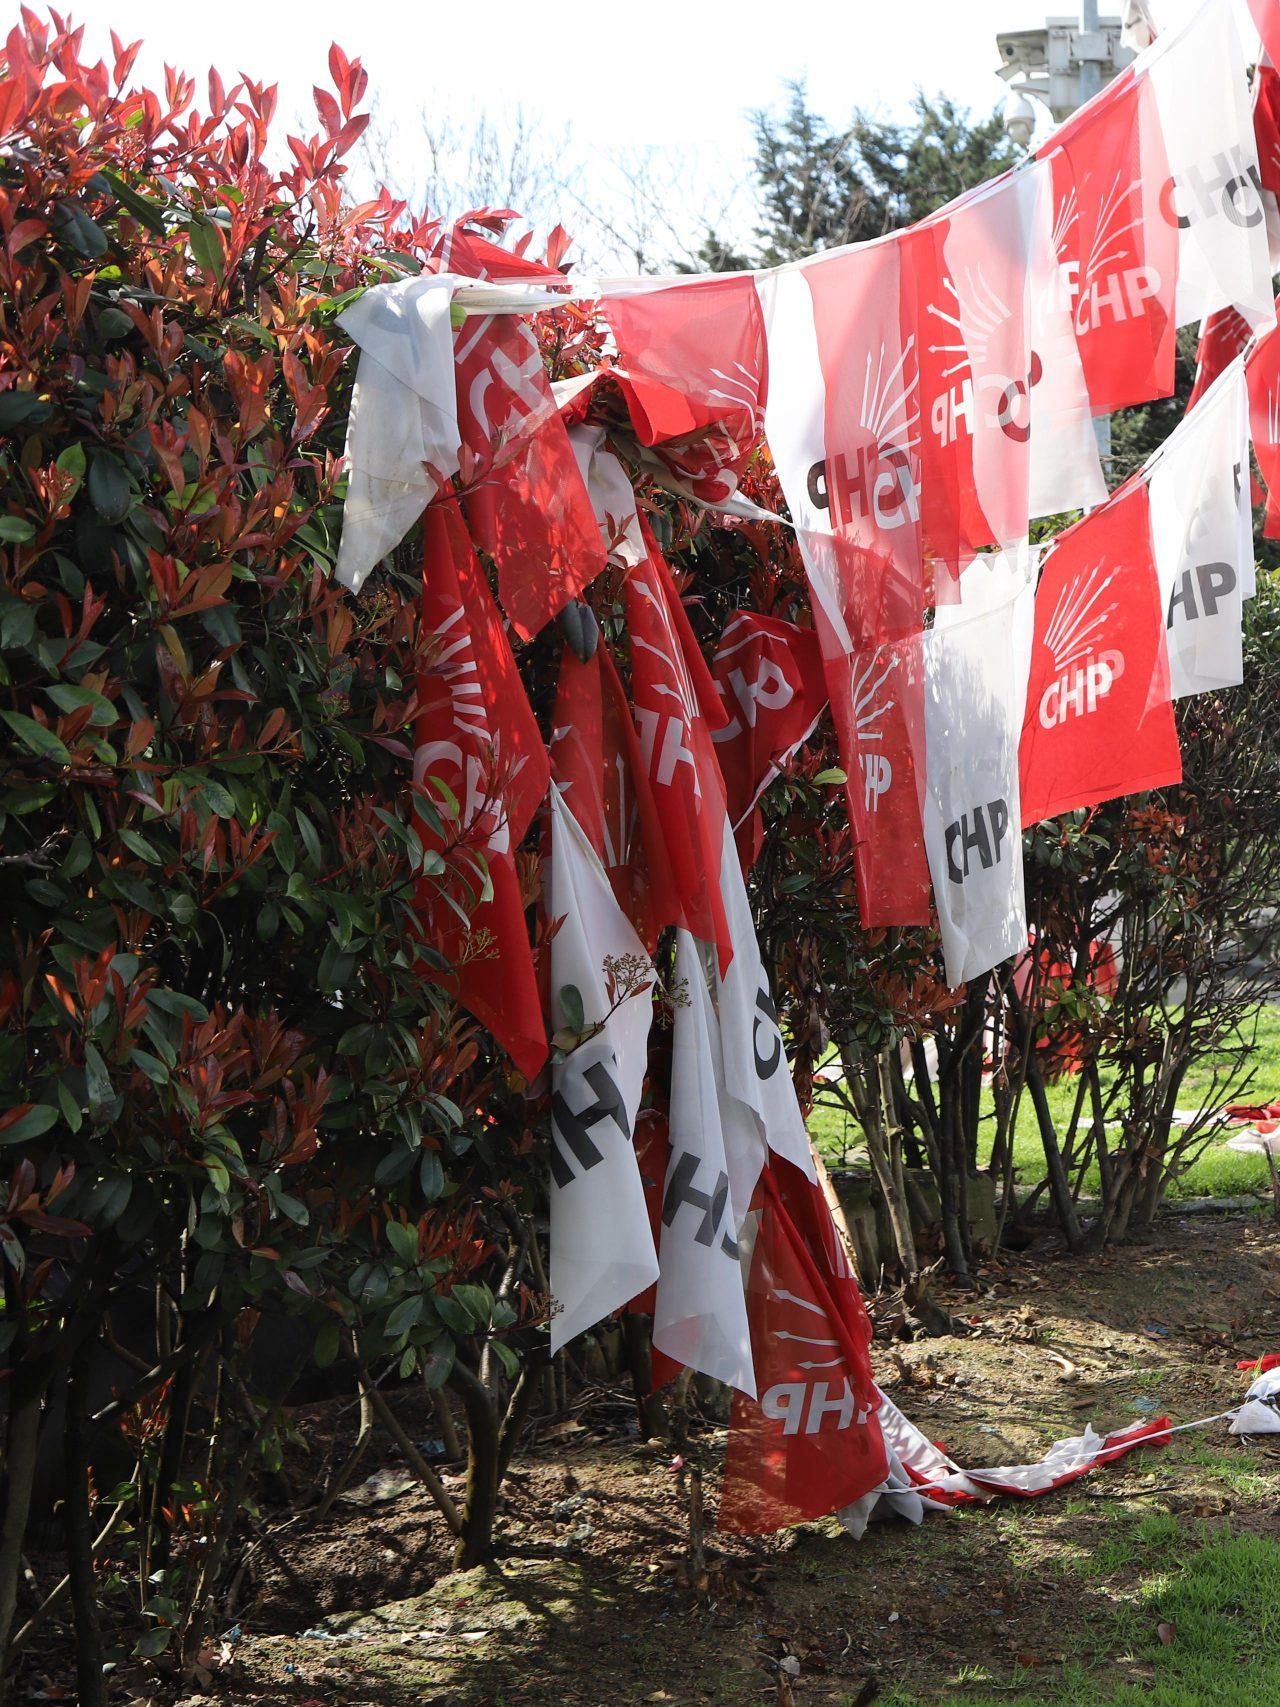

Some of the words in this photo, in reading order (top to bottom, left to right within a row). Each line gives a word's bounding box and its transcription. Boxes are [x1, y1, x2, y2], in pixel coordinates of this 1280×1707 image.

[1076, 267, 1161, 336] CHP
[1167, 562, 1237, 630] HP
[1038, 662, 1113, 730] CHP
[858, 753, 892, 812] HP
[945, 799, 1009, 884] CHP
